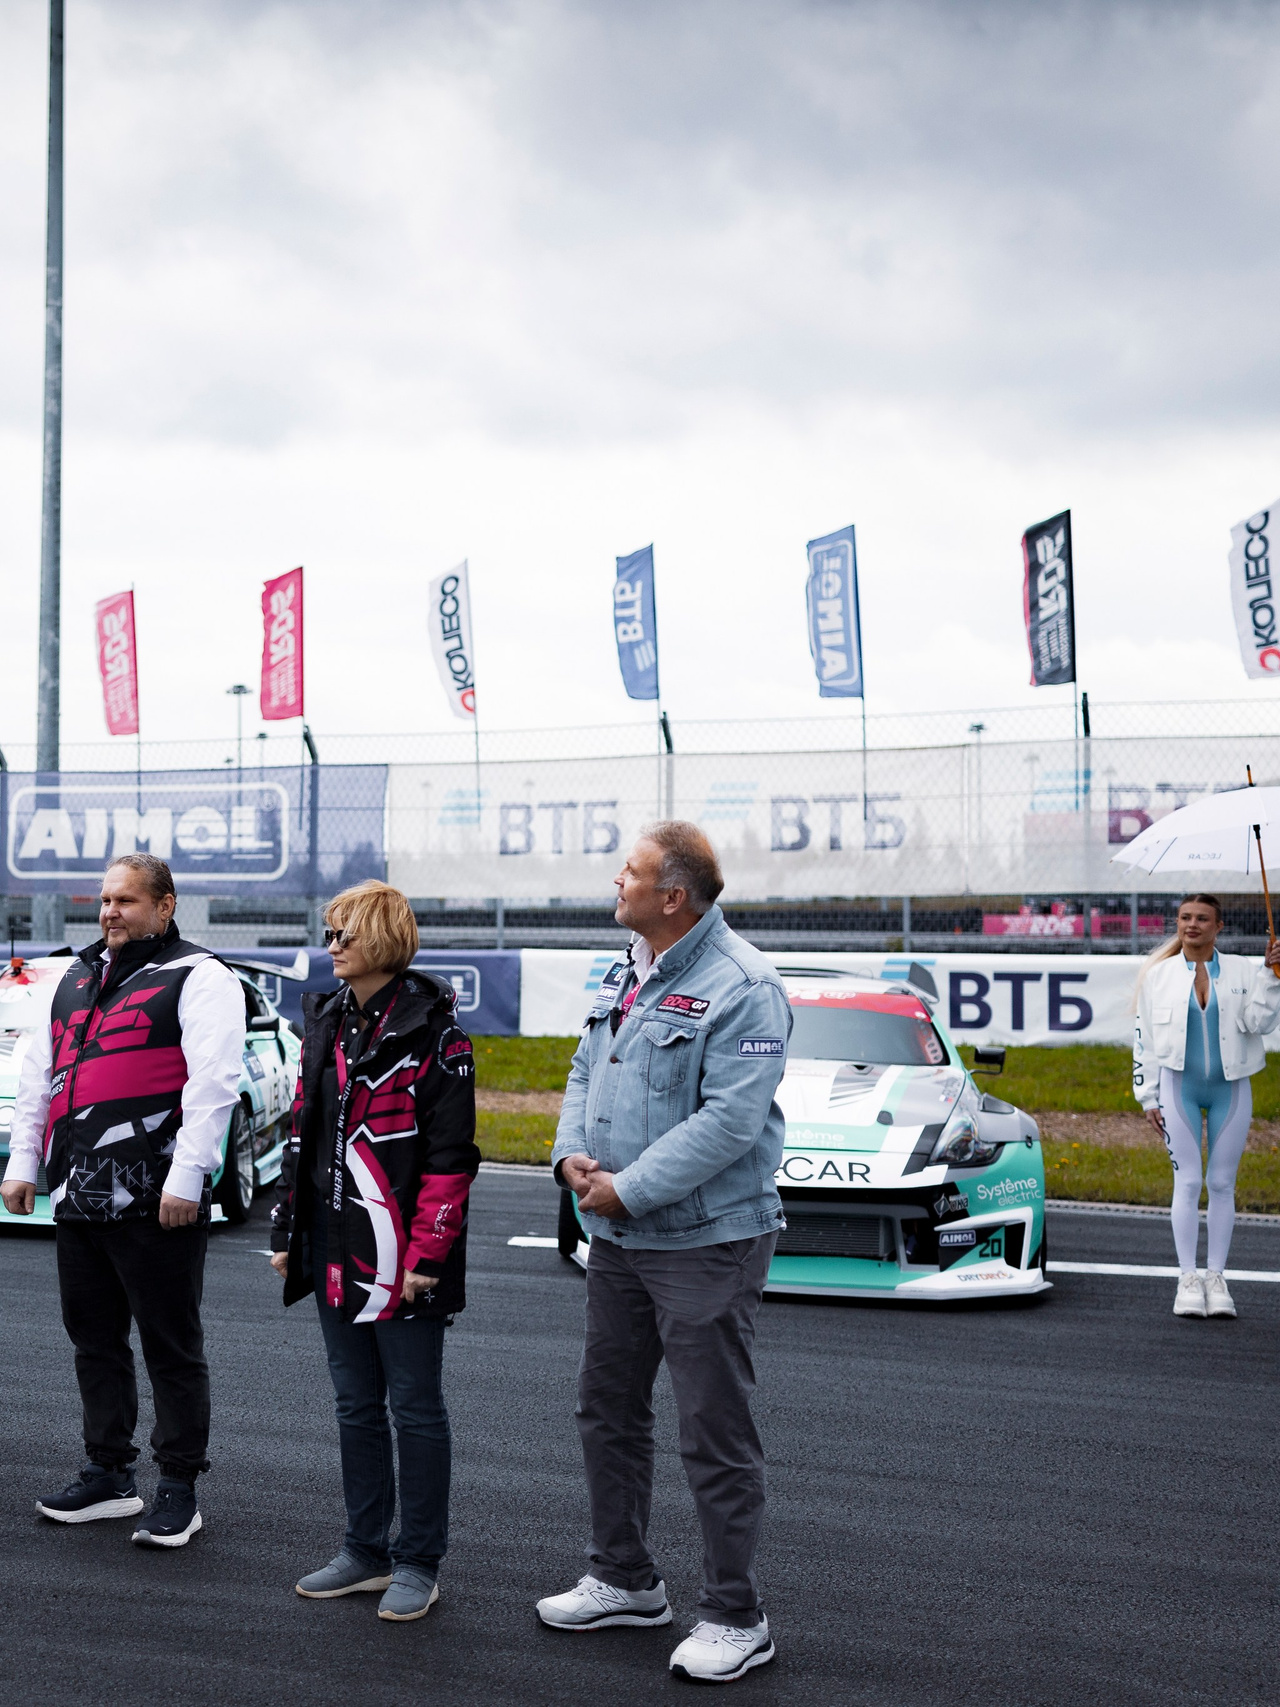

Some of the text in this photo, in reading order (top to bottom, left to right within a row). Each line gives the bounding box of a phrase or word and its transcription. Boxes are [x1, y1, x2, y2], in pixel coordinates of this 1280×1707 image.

[19, 806, 273, 861] AIMOL
[499, 800, 620, 856] ВТБ
[770, 792, 908, 851] ВТБ
[691, 1000, 708, 1010] GP
[948, 971, 1094, 1031] ВТБ
[741, 1039, 783, 1054] AIMOL
[776, 1156, 872, 1183] CAR
[332, 1168, 344, 1211] SERIES
[977, 1177, 1038, 1200] Systême
[998, 1189, 1042, 1206] electric
[941, 1233, 974, 1244] AIMOL
[979, 1238, 1002, 1258] 20
